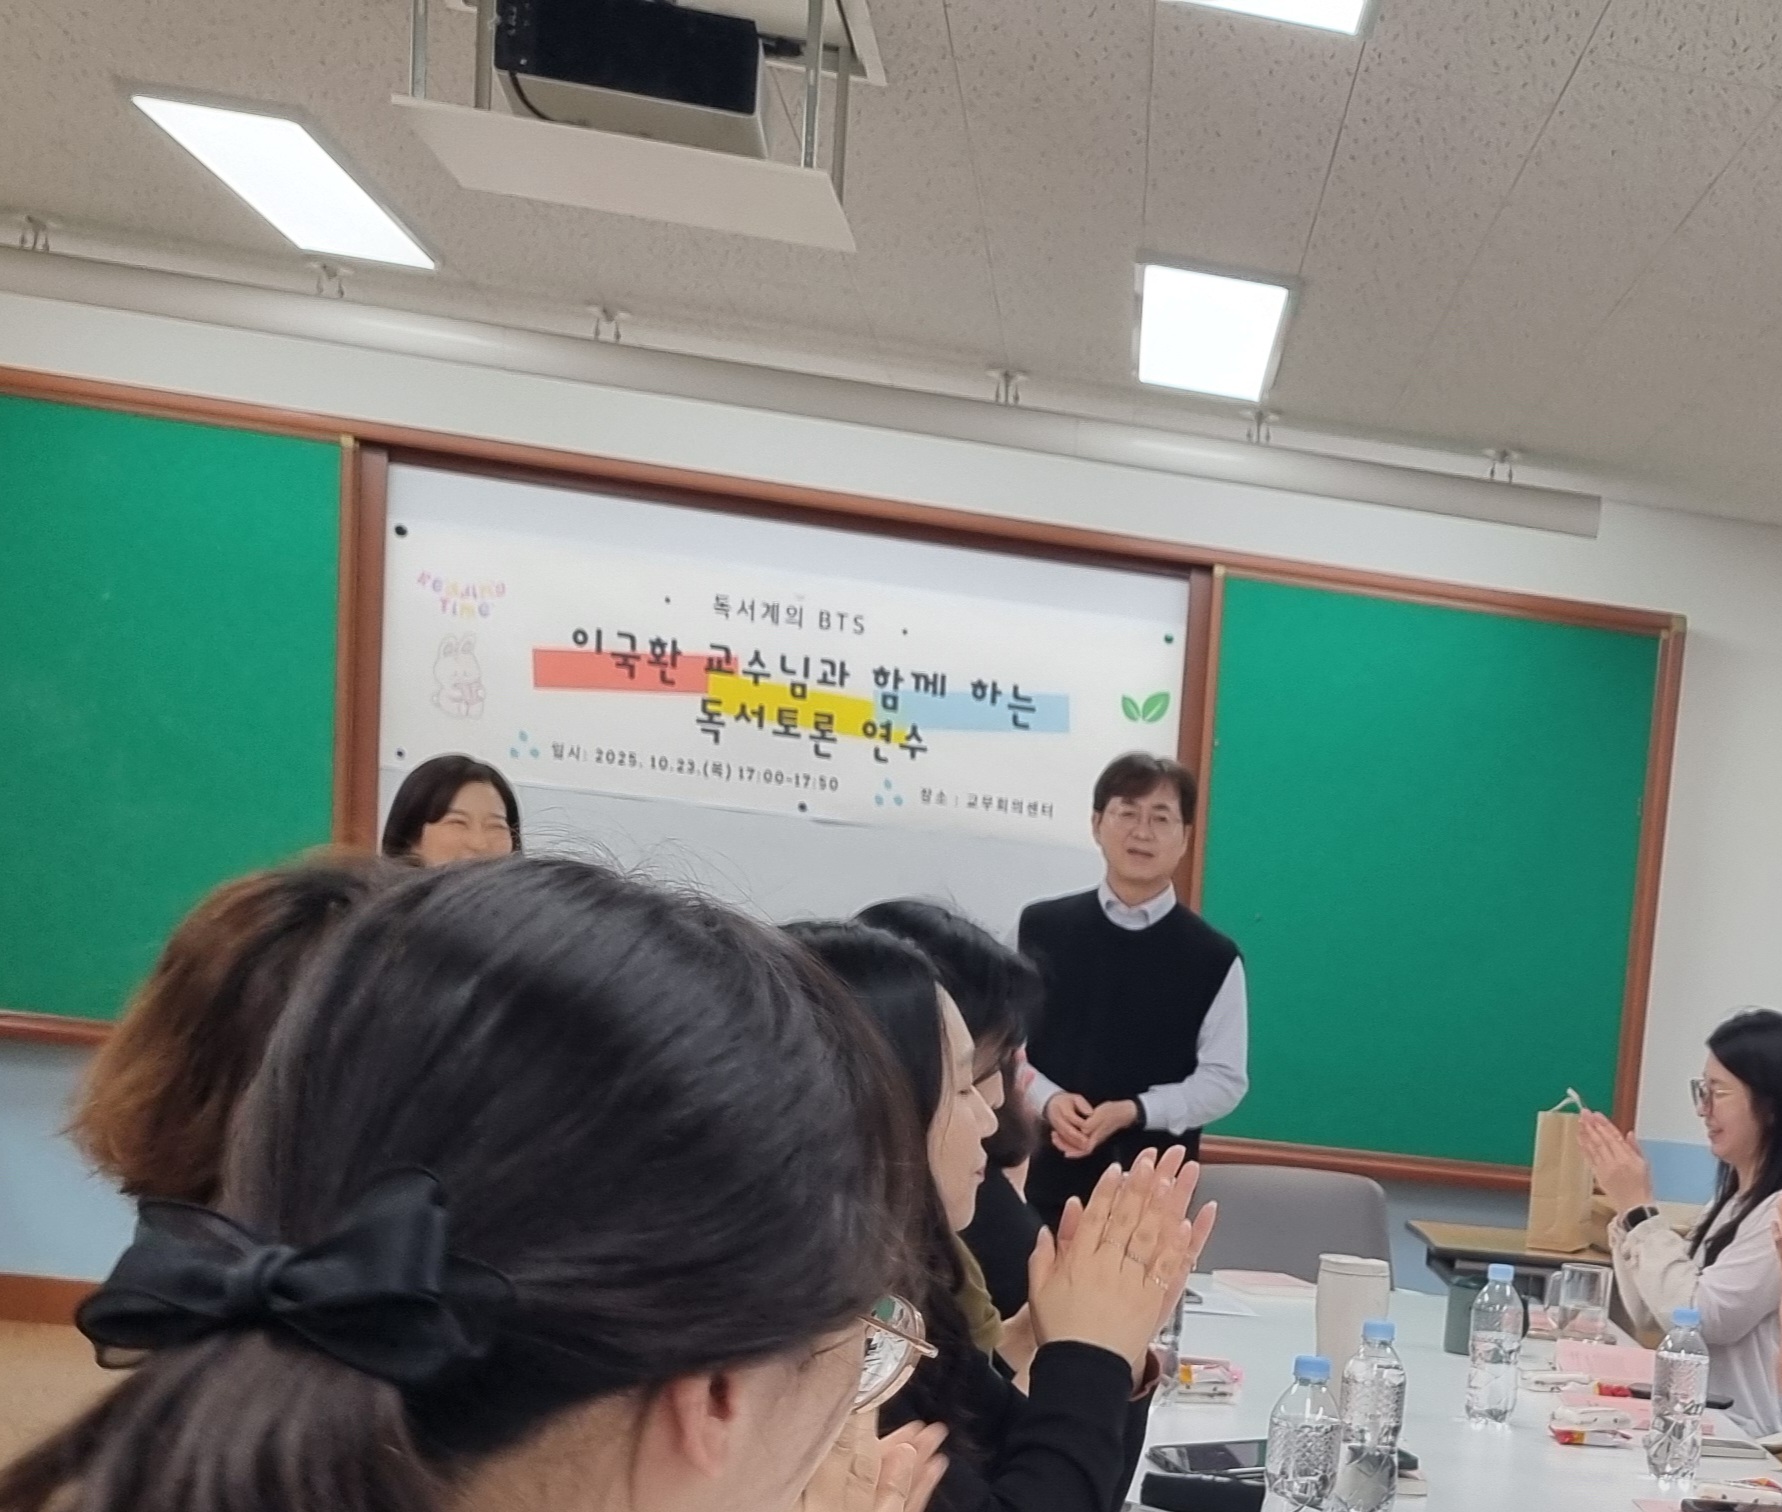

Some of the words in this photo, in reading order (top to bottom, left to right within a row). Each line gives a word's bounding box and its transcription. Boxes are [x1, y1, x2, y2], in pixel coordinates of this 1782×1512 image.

[713, 594, 803, 629] 독서계의
[819, 610, 866, 635] BTS
[572, 628, 683, 686] 이국환
[705, 643, 850, 700] 교수님과
[873, 666, 947, 711] 함께
[970, 678, 1036, 730] 하는
[696, 698, 837, 758] 독서토론
[862, 720, 928, 763] 연수
